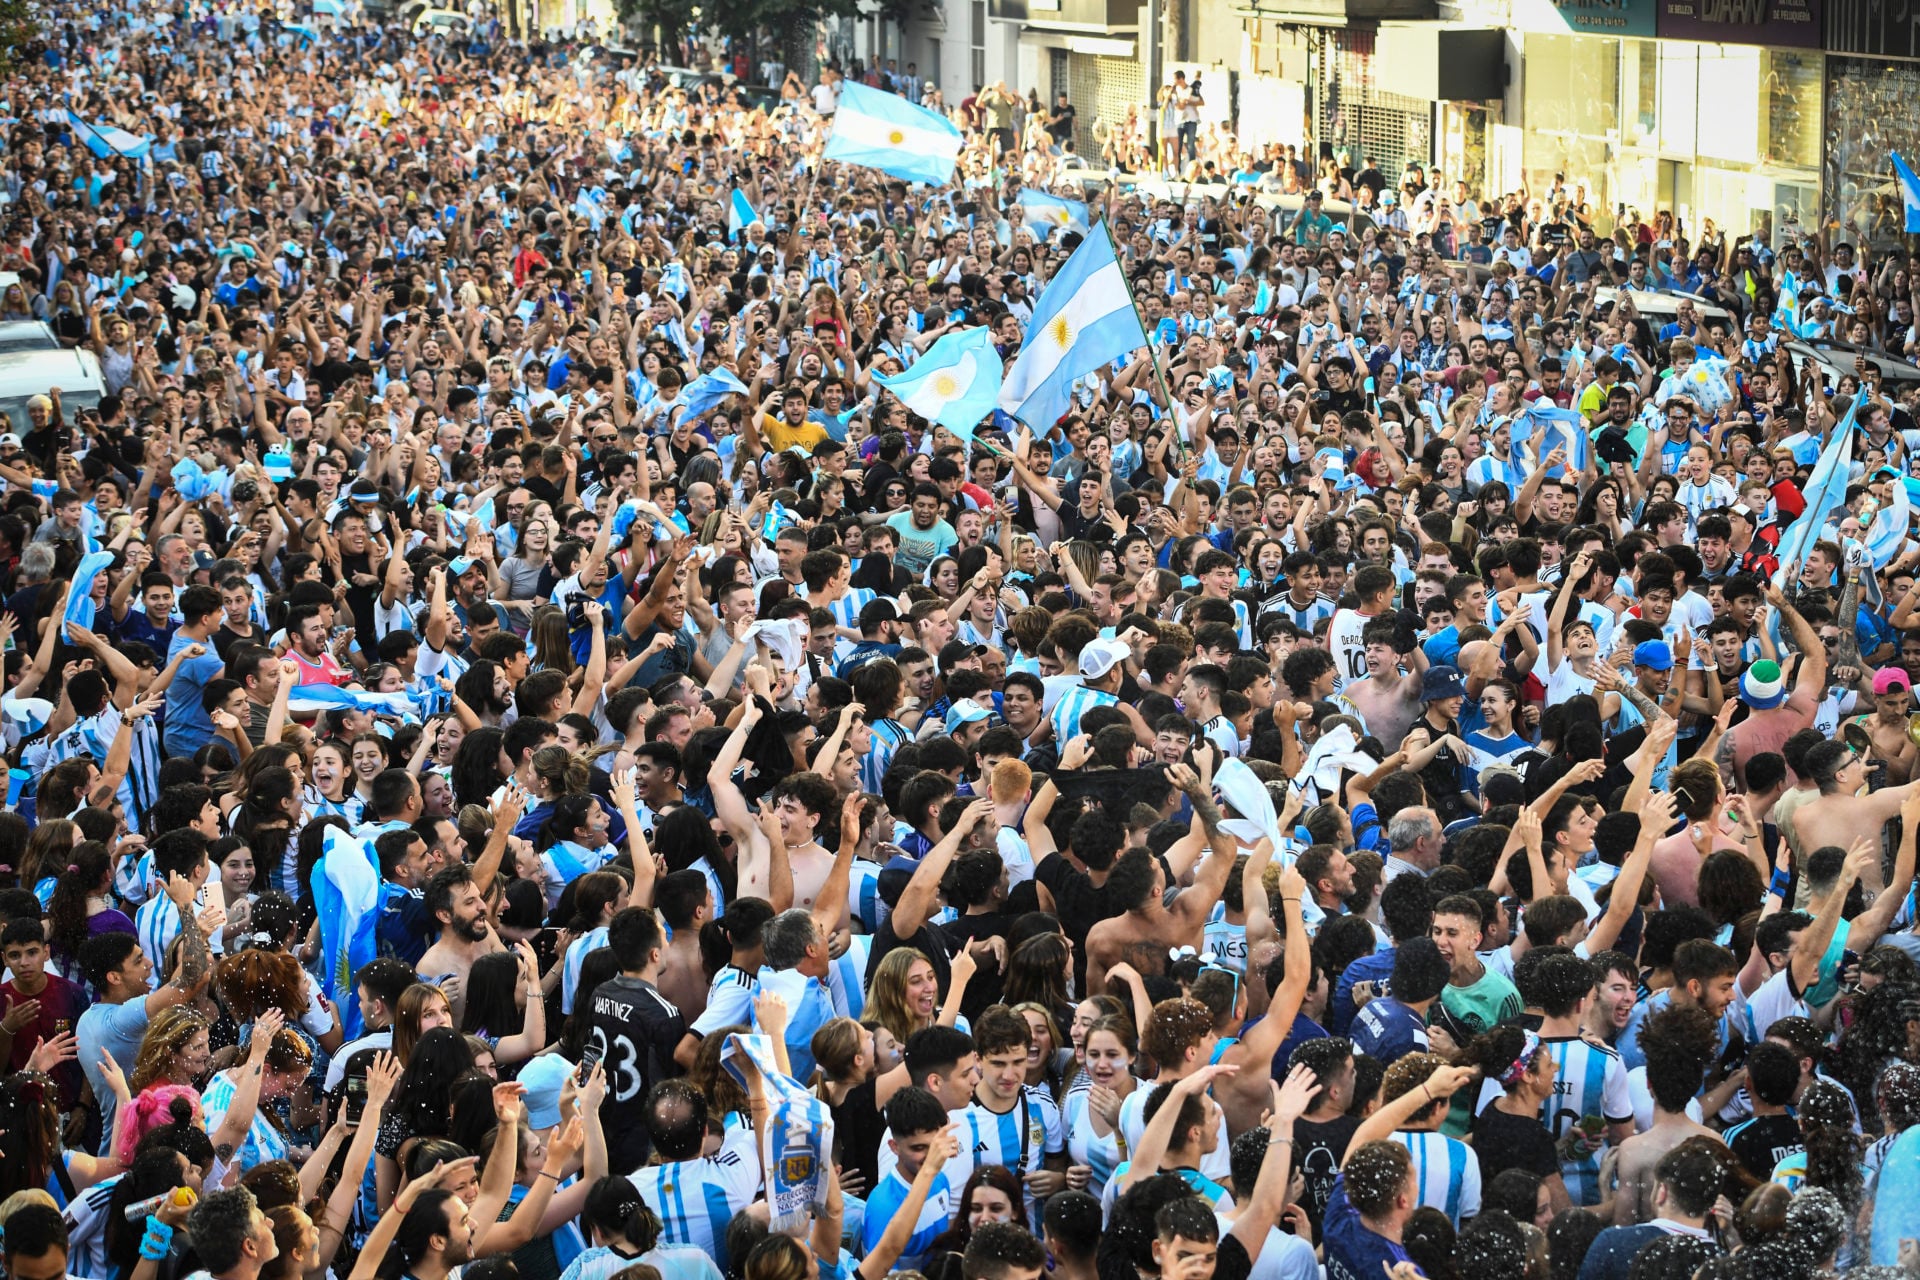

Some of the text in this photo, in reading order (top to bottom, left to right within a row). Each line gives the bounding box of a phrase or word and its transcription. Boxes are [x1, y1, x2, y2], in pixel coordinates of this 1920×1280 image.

[1674, 5, 1693, 15] BELLEZA
[1773, 9, 1780, 20] DE
[1343, 648, 1368, 679] 10
